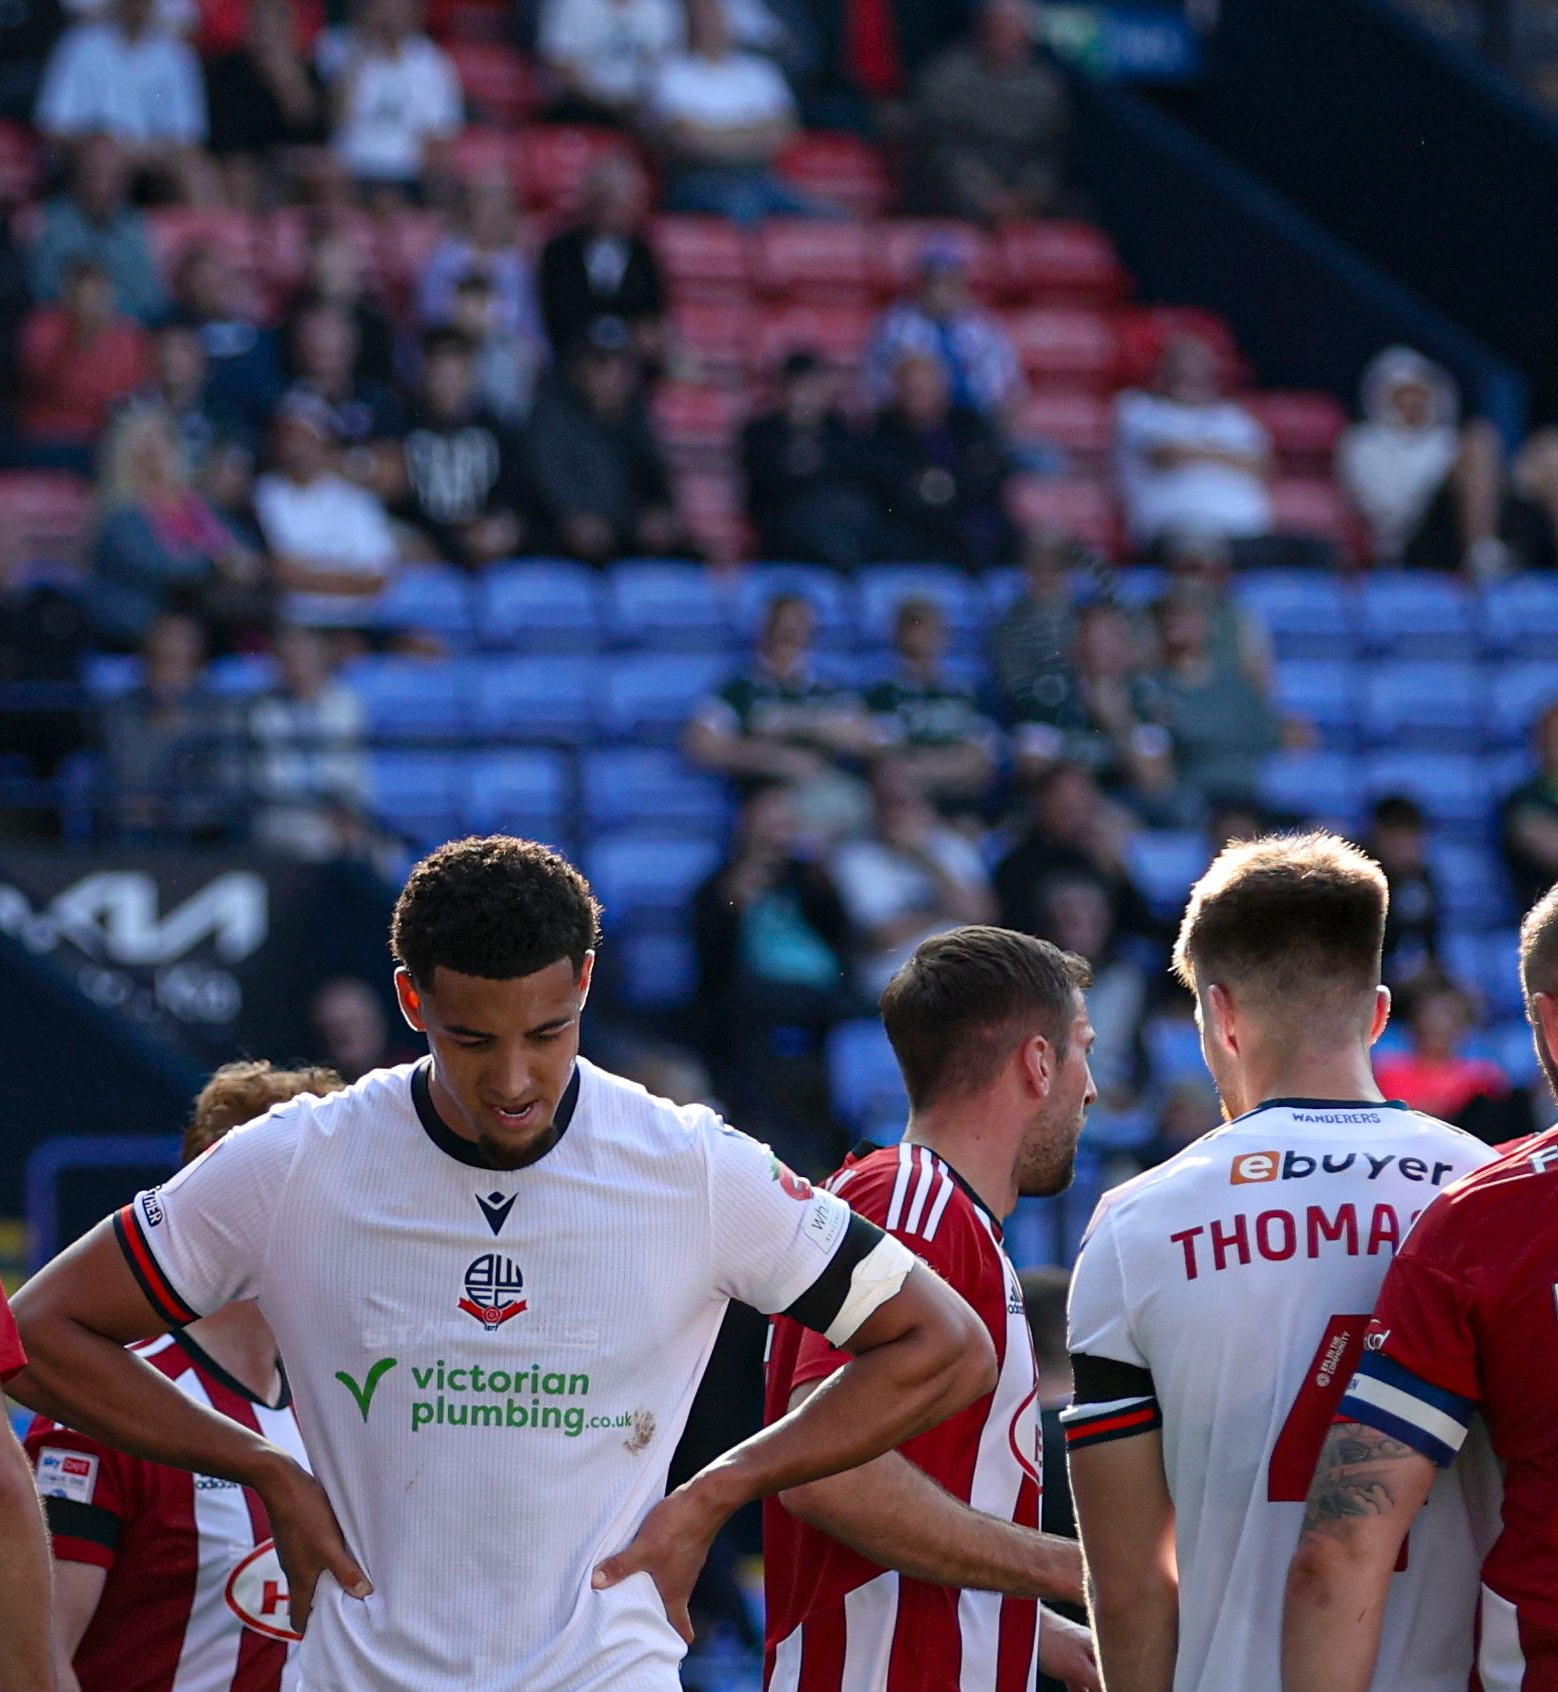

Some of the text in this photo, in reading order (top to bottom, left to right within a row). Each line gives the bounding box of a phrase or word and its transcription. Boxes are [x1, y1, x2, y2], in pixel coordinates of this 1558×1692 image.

[1293, 1112, 1381, 1124] WANDERERS
[1237, 1150, 1454, 1187] ebuyer
[1170, 1202, 1422, 1281] THOMA
[411, 1360, 590, 1395] victorian
